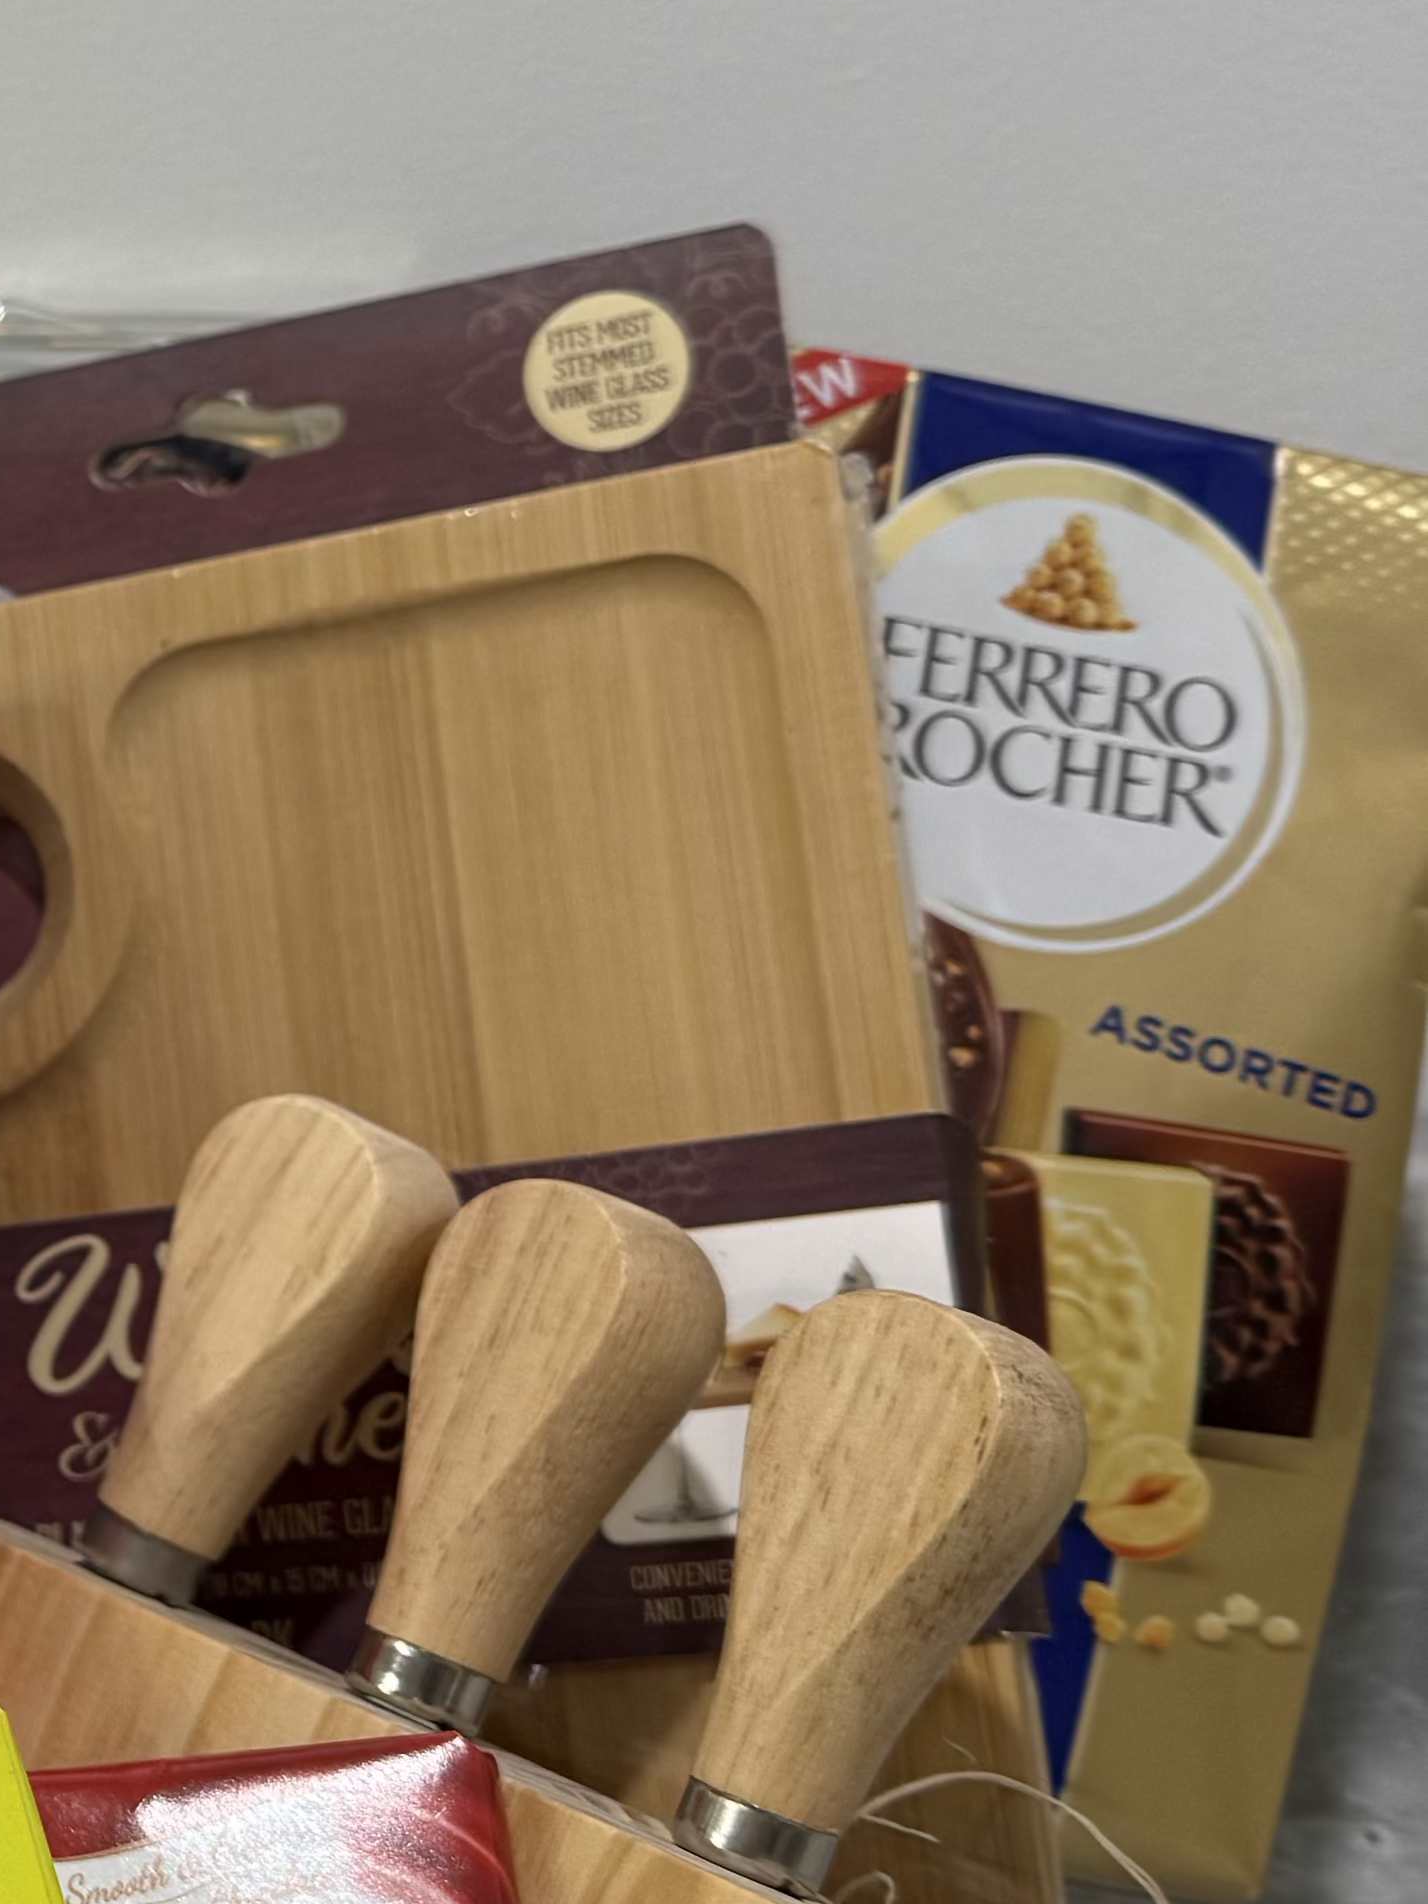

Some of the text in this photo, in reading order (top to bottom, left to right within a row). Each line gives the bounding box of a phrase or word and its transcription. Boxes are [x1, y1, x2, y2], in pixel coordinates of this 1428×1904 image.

[546, 309, 655, 355] FITS MOST
[553, 340, 657, 383] STEMMED
[546, 366, 672, 413] WINE GLASS
[587, 401, 644, 435] SIZES
[882, 615, 1238, 753] FERRERO
[1089, 1003, 1378, 1121] ASSORTED
